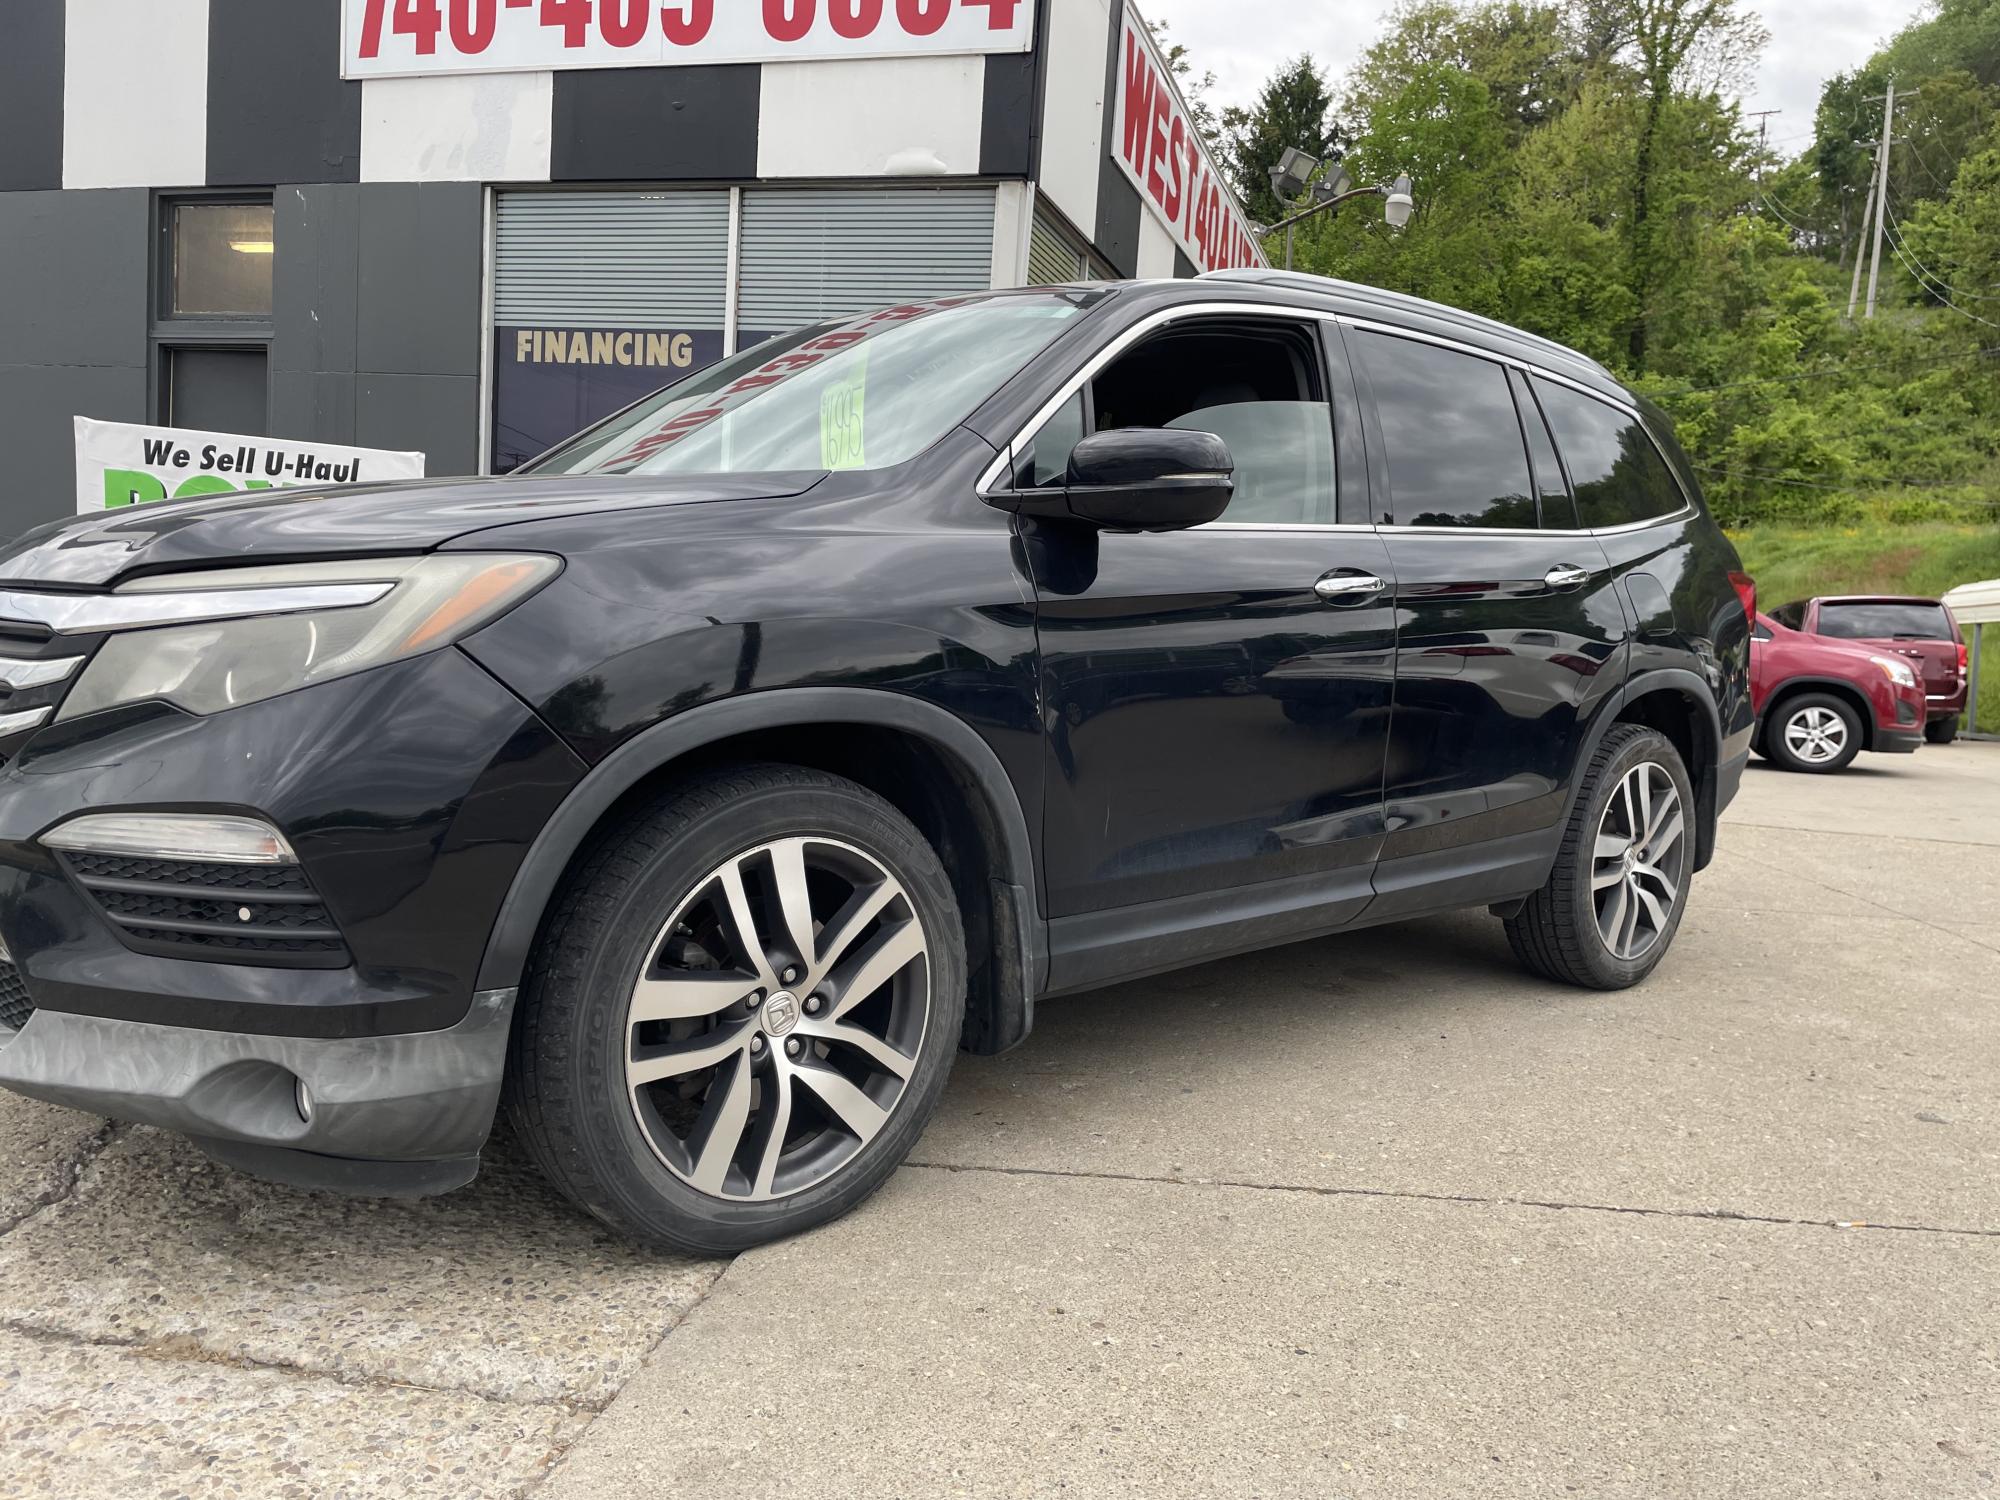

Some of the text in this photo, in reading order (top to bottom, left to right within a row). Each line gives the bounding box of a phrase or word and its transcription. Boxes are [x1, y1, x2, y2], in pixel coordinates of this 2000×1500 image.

[516, 330, 693, 368] FINANCING
[143, 438, 360, 482] We Sell U-Haul
